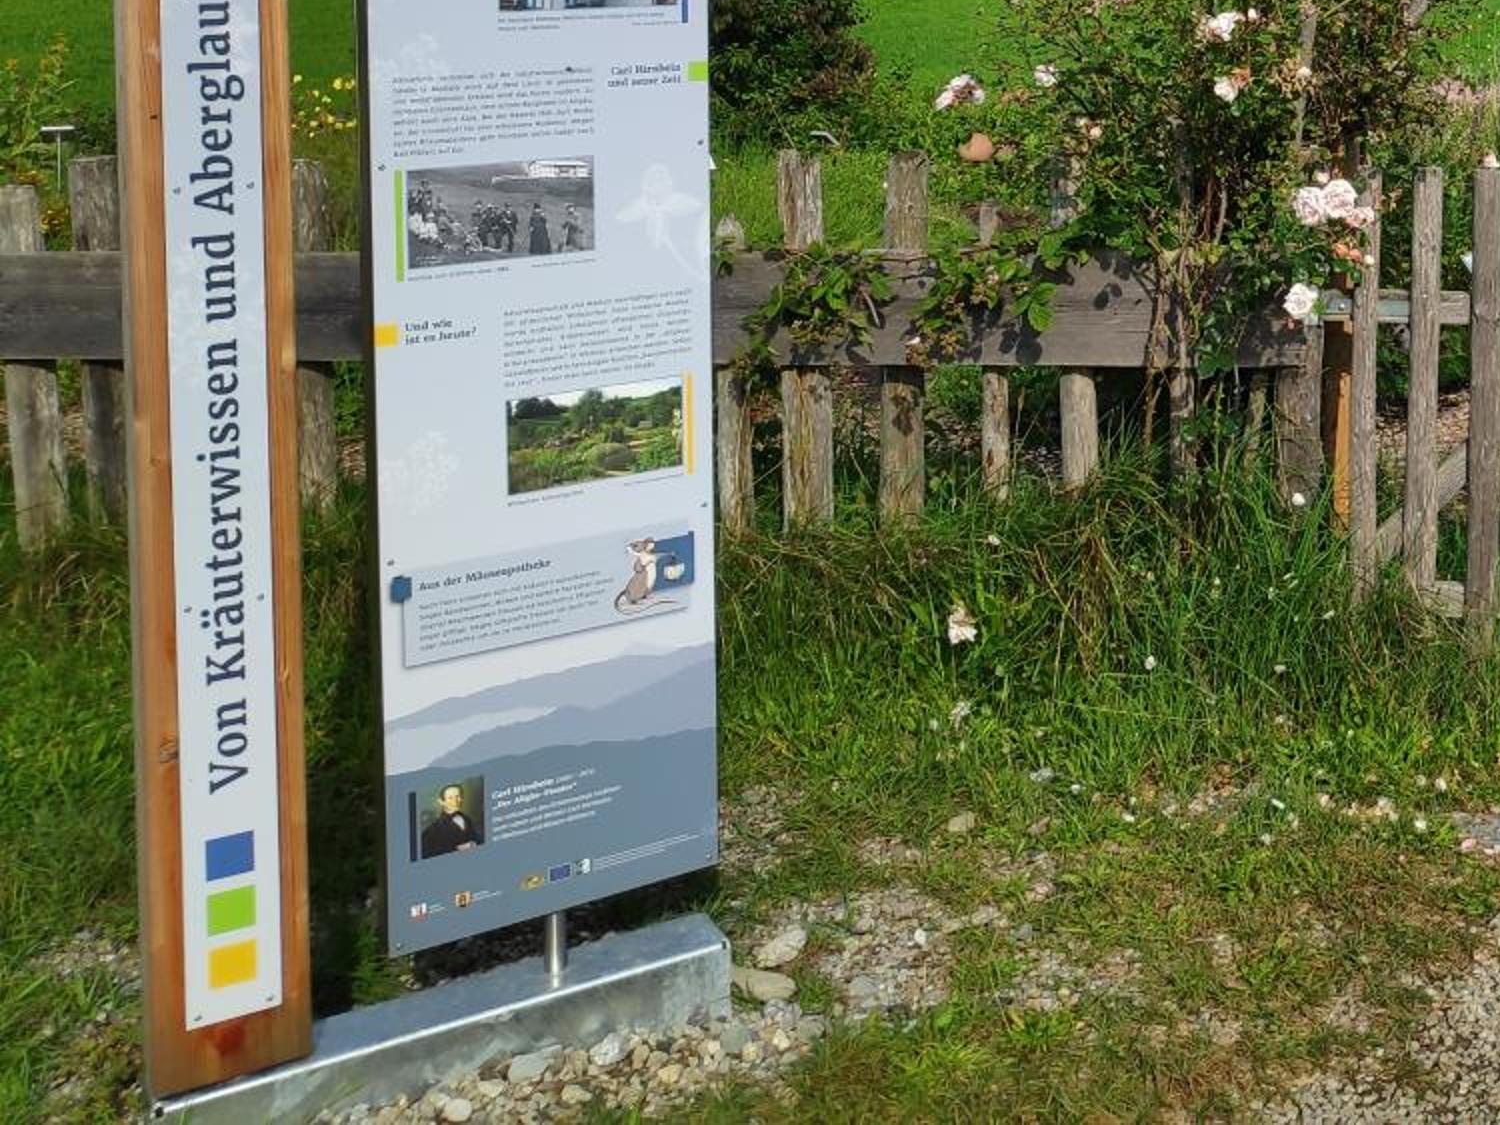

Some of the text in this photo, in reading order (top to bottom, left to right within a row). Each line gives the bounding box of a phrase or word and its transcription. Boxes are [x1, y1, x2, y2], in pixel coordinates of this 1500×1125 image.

[192, 232, 237, 322] und
[405, 319, 452, 332] Und wie
[439, 326, 476, 341] heute?
[196, 339, 247, 685] Kräuterwissen
[420, 559, 551, 592] Aus der Mäuseapotheke
[209, 698, 248, 796] Von
